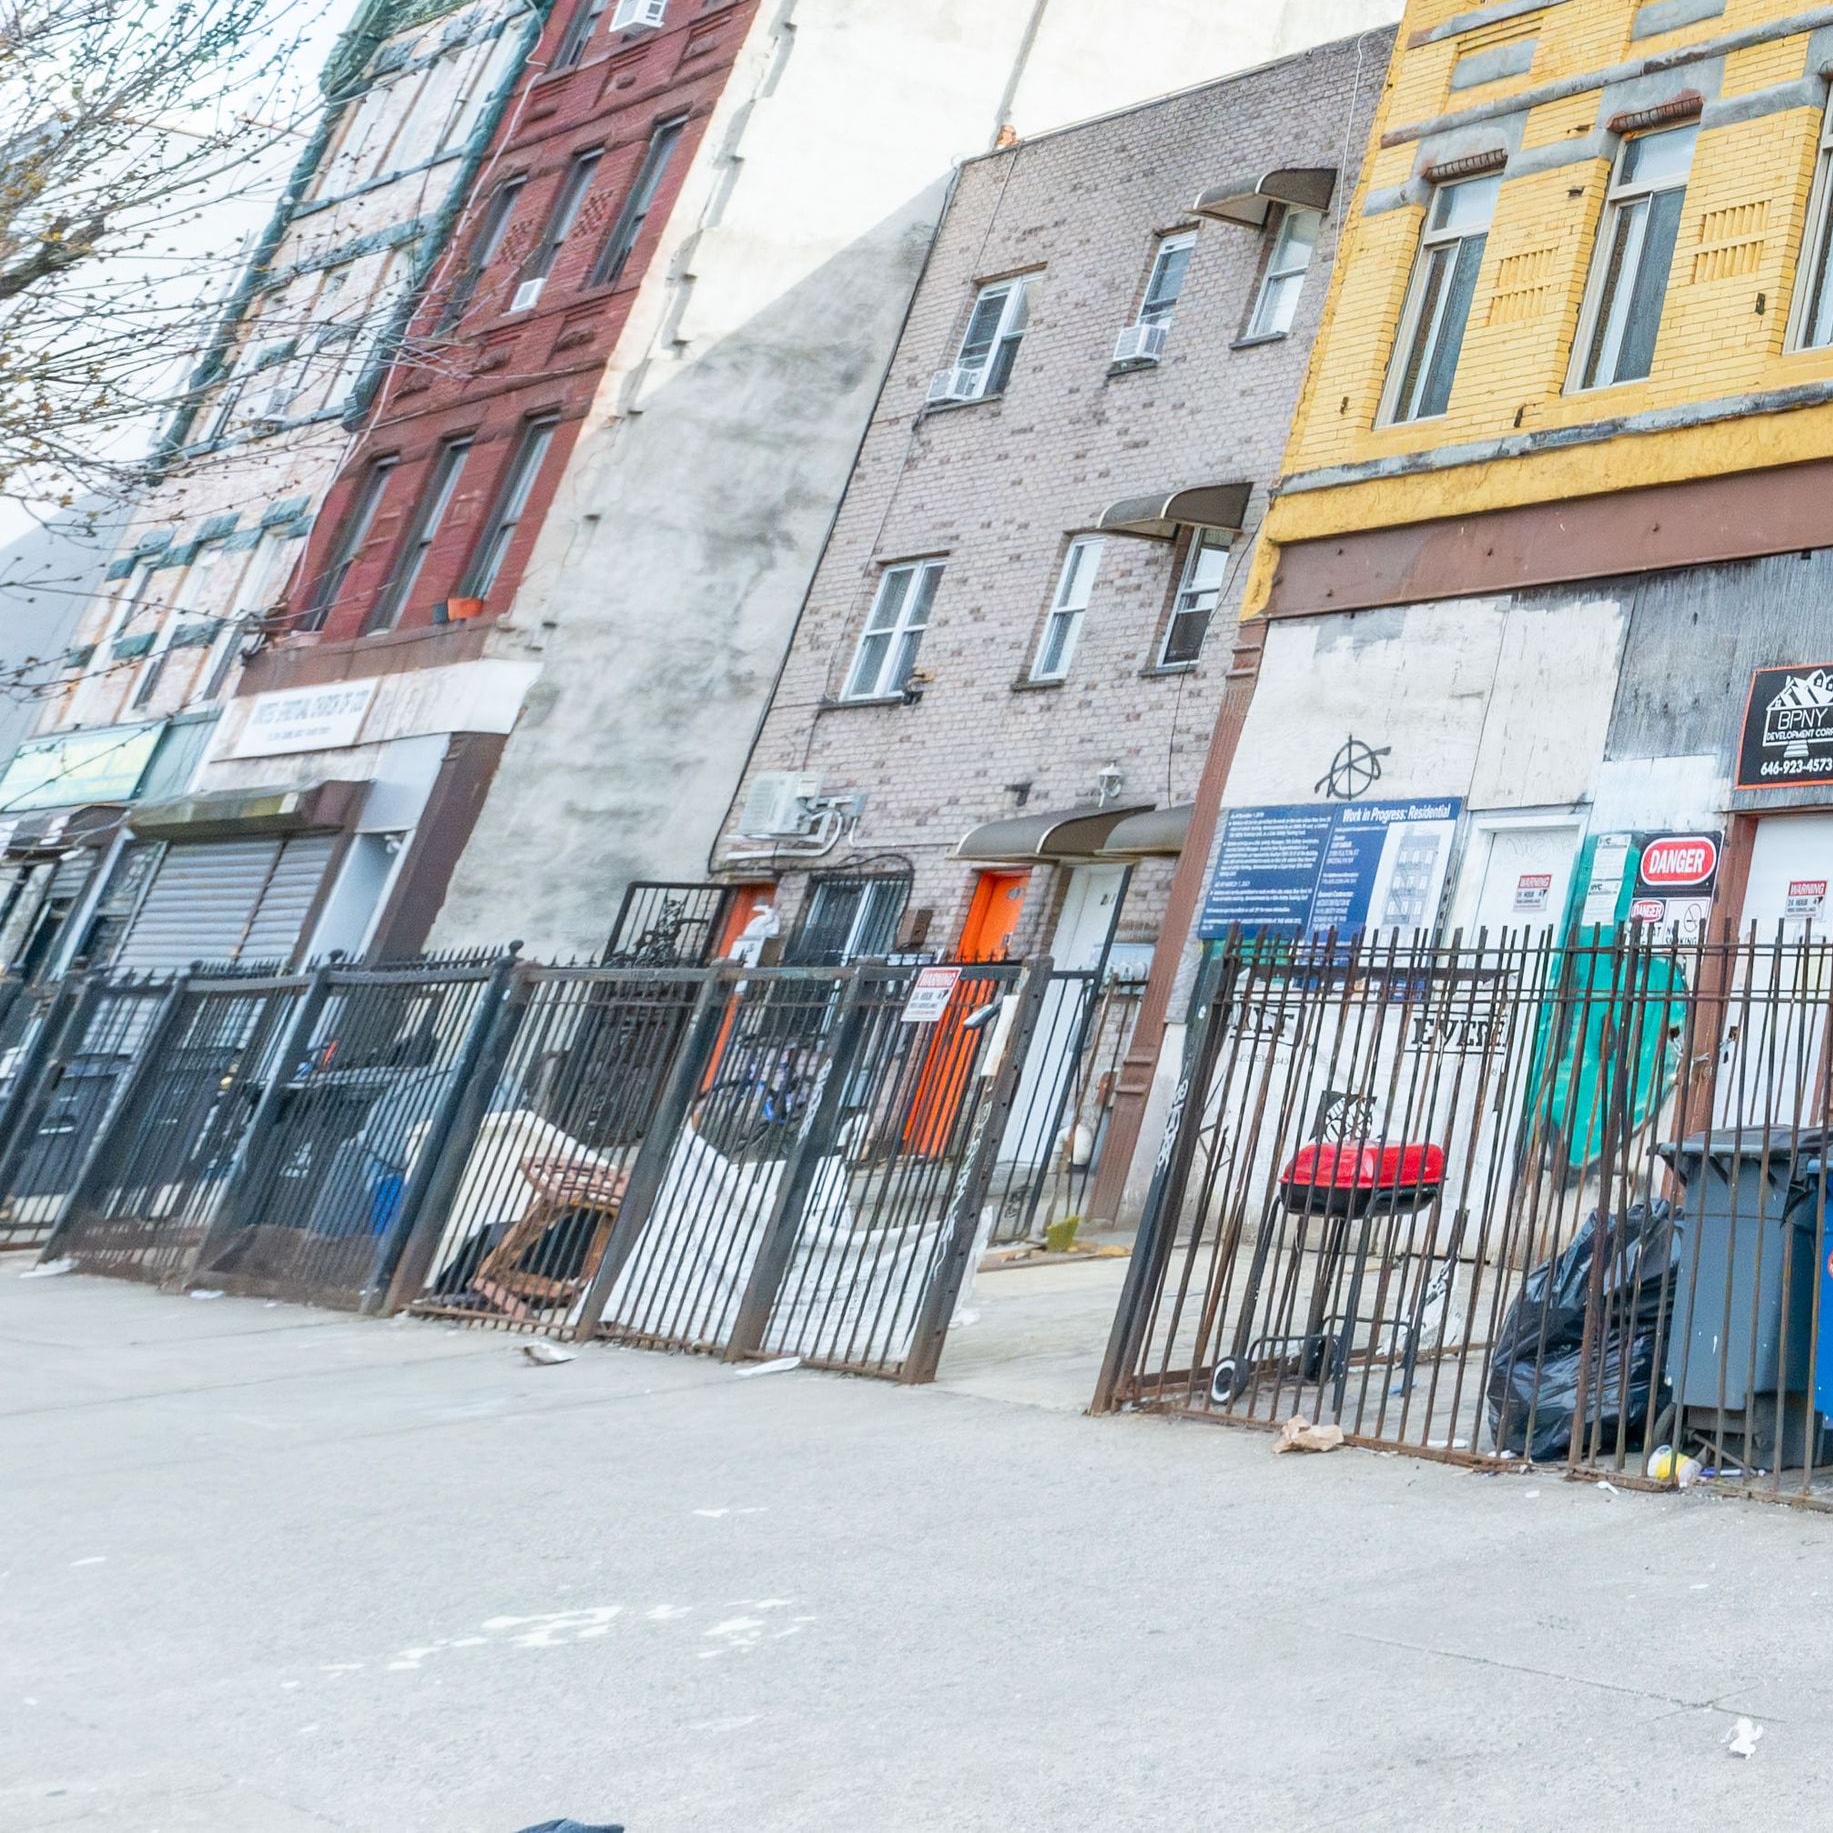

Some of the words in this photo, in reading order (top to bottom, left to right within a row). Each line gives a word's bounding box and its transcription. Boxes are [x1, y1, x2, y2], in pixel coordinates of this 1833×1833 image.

[1778, 708, 1828, 730] BPNY
[1766, 729, 1814, 741] DEVELOPMENT
[1760, 757, 1833, 776] 646-923-4573
[1342, 806, 1362, 823] Work
[1362, 807, 1370, 821] in
[1370, 806, 1408, 824] Progress:
[1408, 804, 1451, 821] Residential
[1649, 848, 1706, 874] DANGER
[1791, 883, 1825, 894] WARNING
[1631, 905, 1661, 918] DANGER
